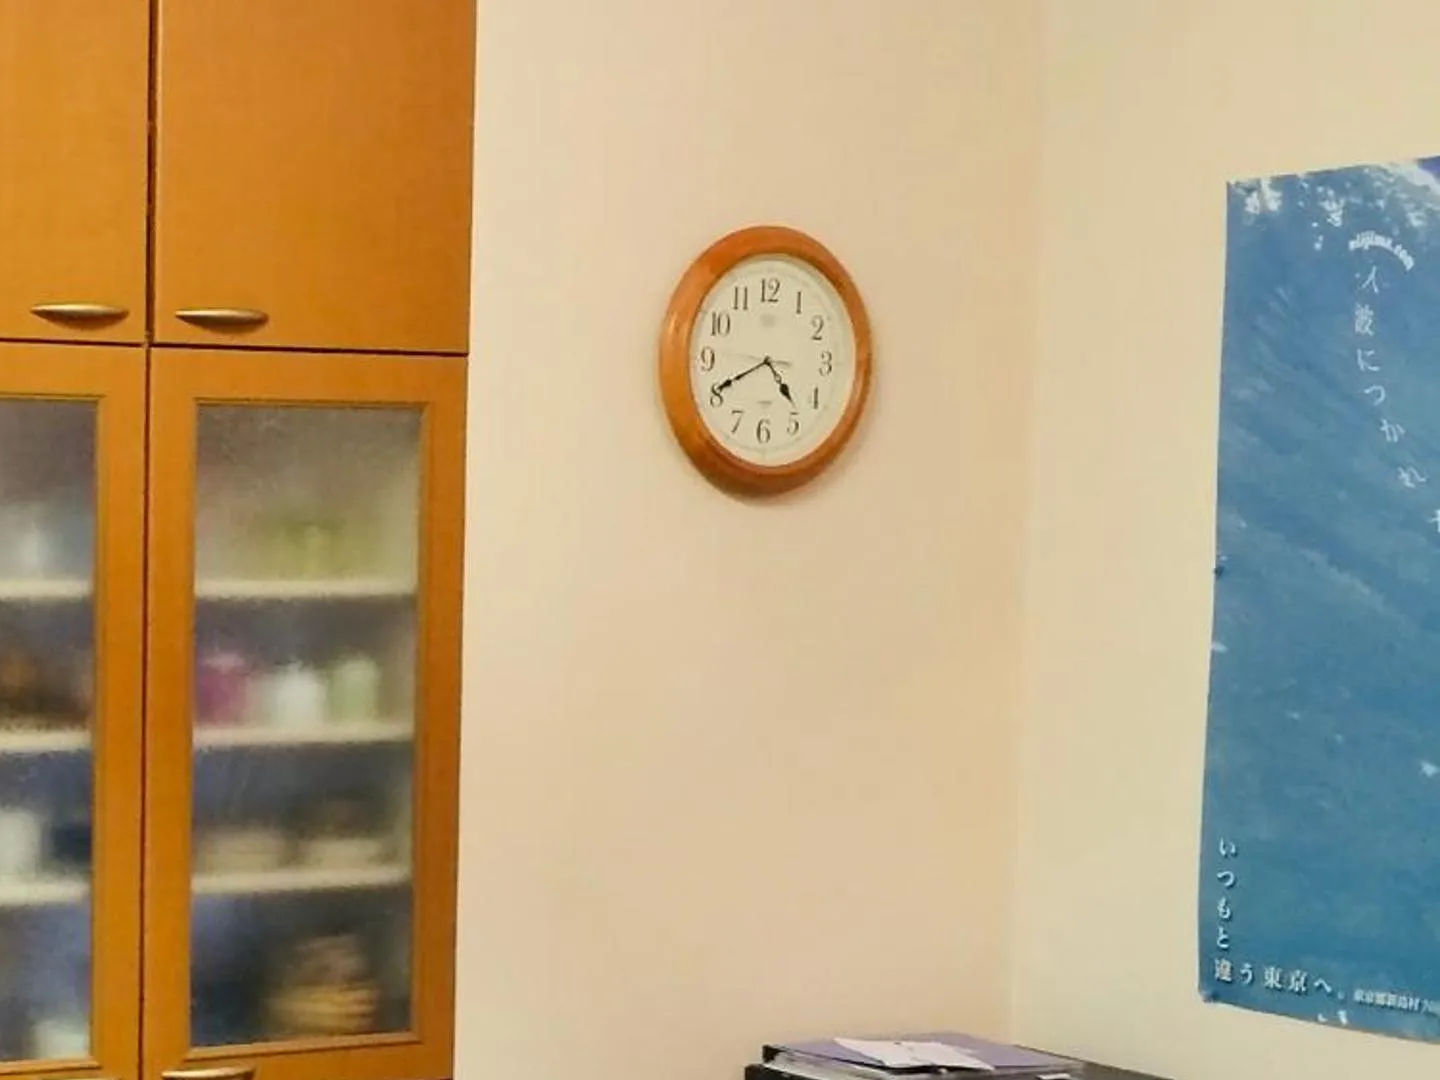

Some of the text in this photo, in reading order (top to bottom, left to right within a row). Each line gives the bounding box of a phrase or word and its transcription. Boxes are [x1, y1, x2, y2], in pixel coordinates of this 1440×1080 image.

[733, 285, 749, 311] 11
[760, 277, 780, 302] 12
[795, 291, 803, 314] 1
[710, 312, 731, 336] 10
[811, 315, 824, 340] 2
[700, 346, 715, 371] 9
[818, 351, 833, 376] 3
[709, 384, 724, 407] 8
[729, 409, 744, 433] 7
[755, 418, 771, 443] 6
[786, 411, 800, 435] 5
